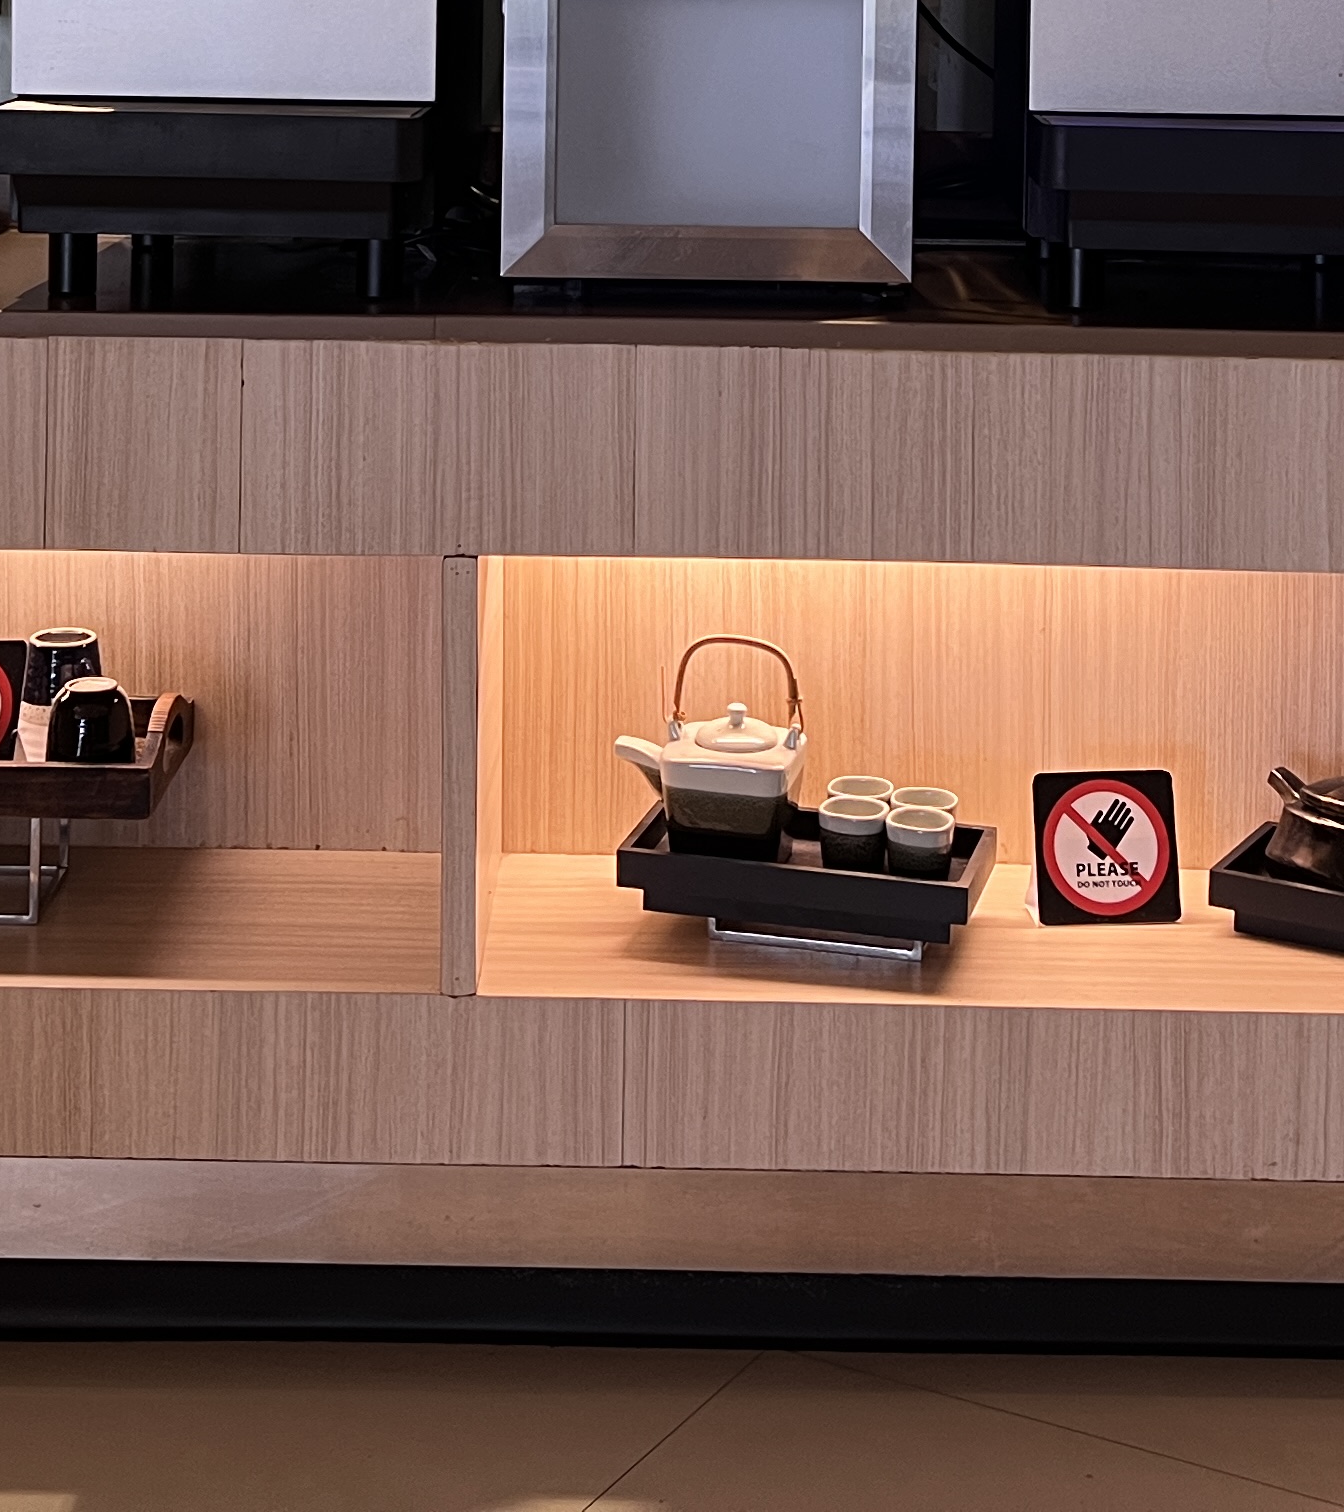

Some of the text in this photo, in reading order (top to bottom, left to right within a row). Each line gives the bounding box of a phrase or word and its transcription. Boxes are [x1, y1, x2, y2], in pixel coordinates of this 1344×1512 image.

[1076, 861, 1139, 877] PLEASE
[1077, 880, 1091, 889] DO
[1092, 879, 1110, 888] NOT
